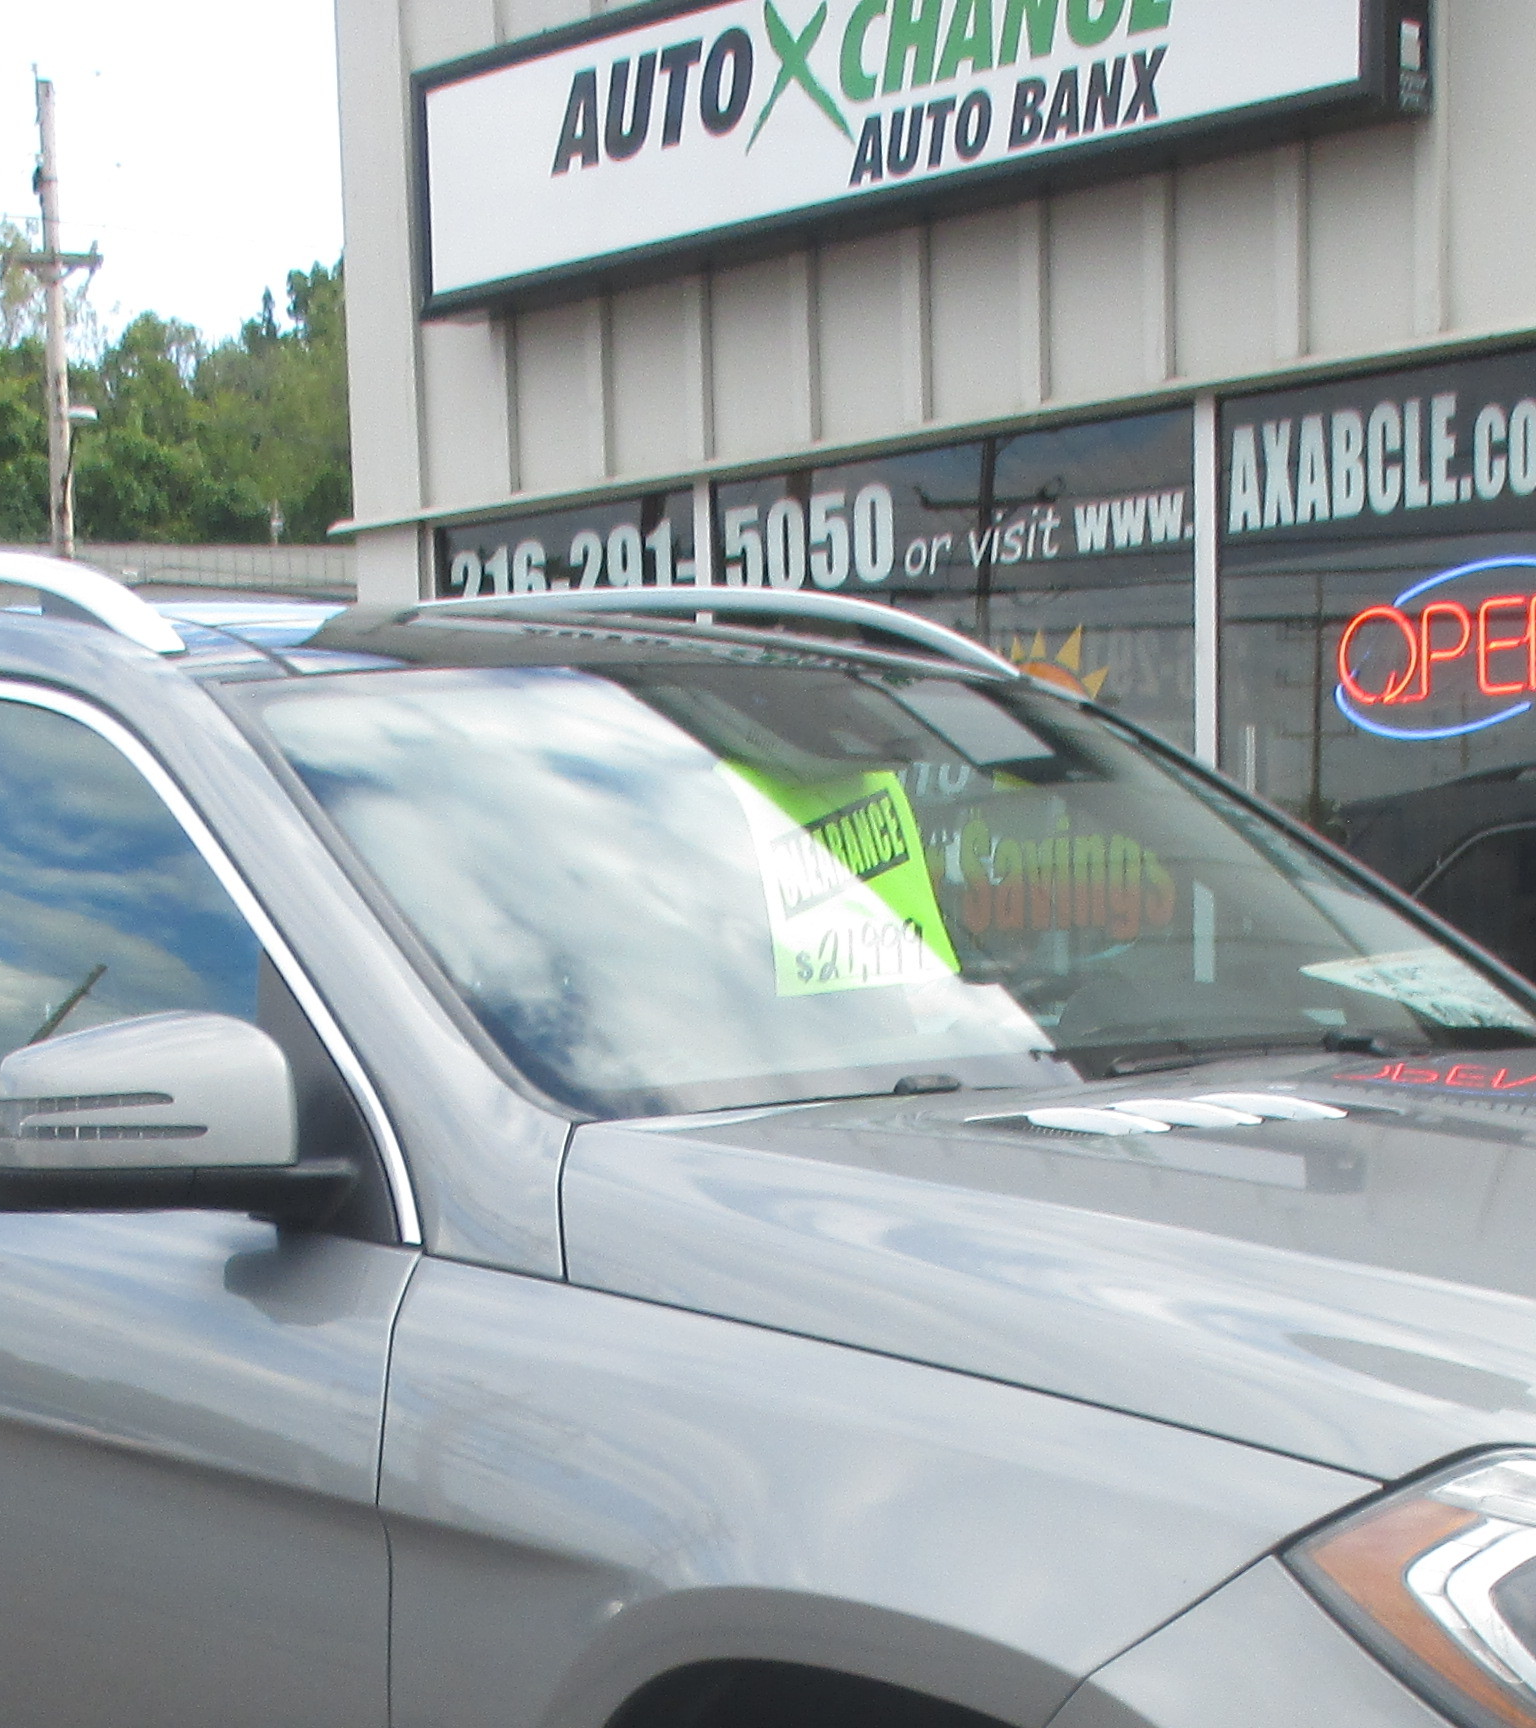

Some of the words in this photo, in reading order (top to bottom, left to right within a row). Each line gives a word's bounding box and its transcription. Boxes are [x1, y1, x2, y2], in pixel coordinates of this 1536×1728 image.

[848, 86, 993, 188] AUTO
[1007, 44, 1169, 152] BANX
[903, 530, 953, 578] or
[967, 504, 1061, 570] visit
